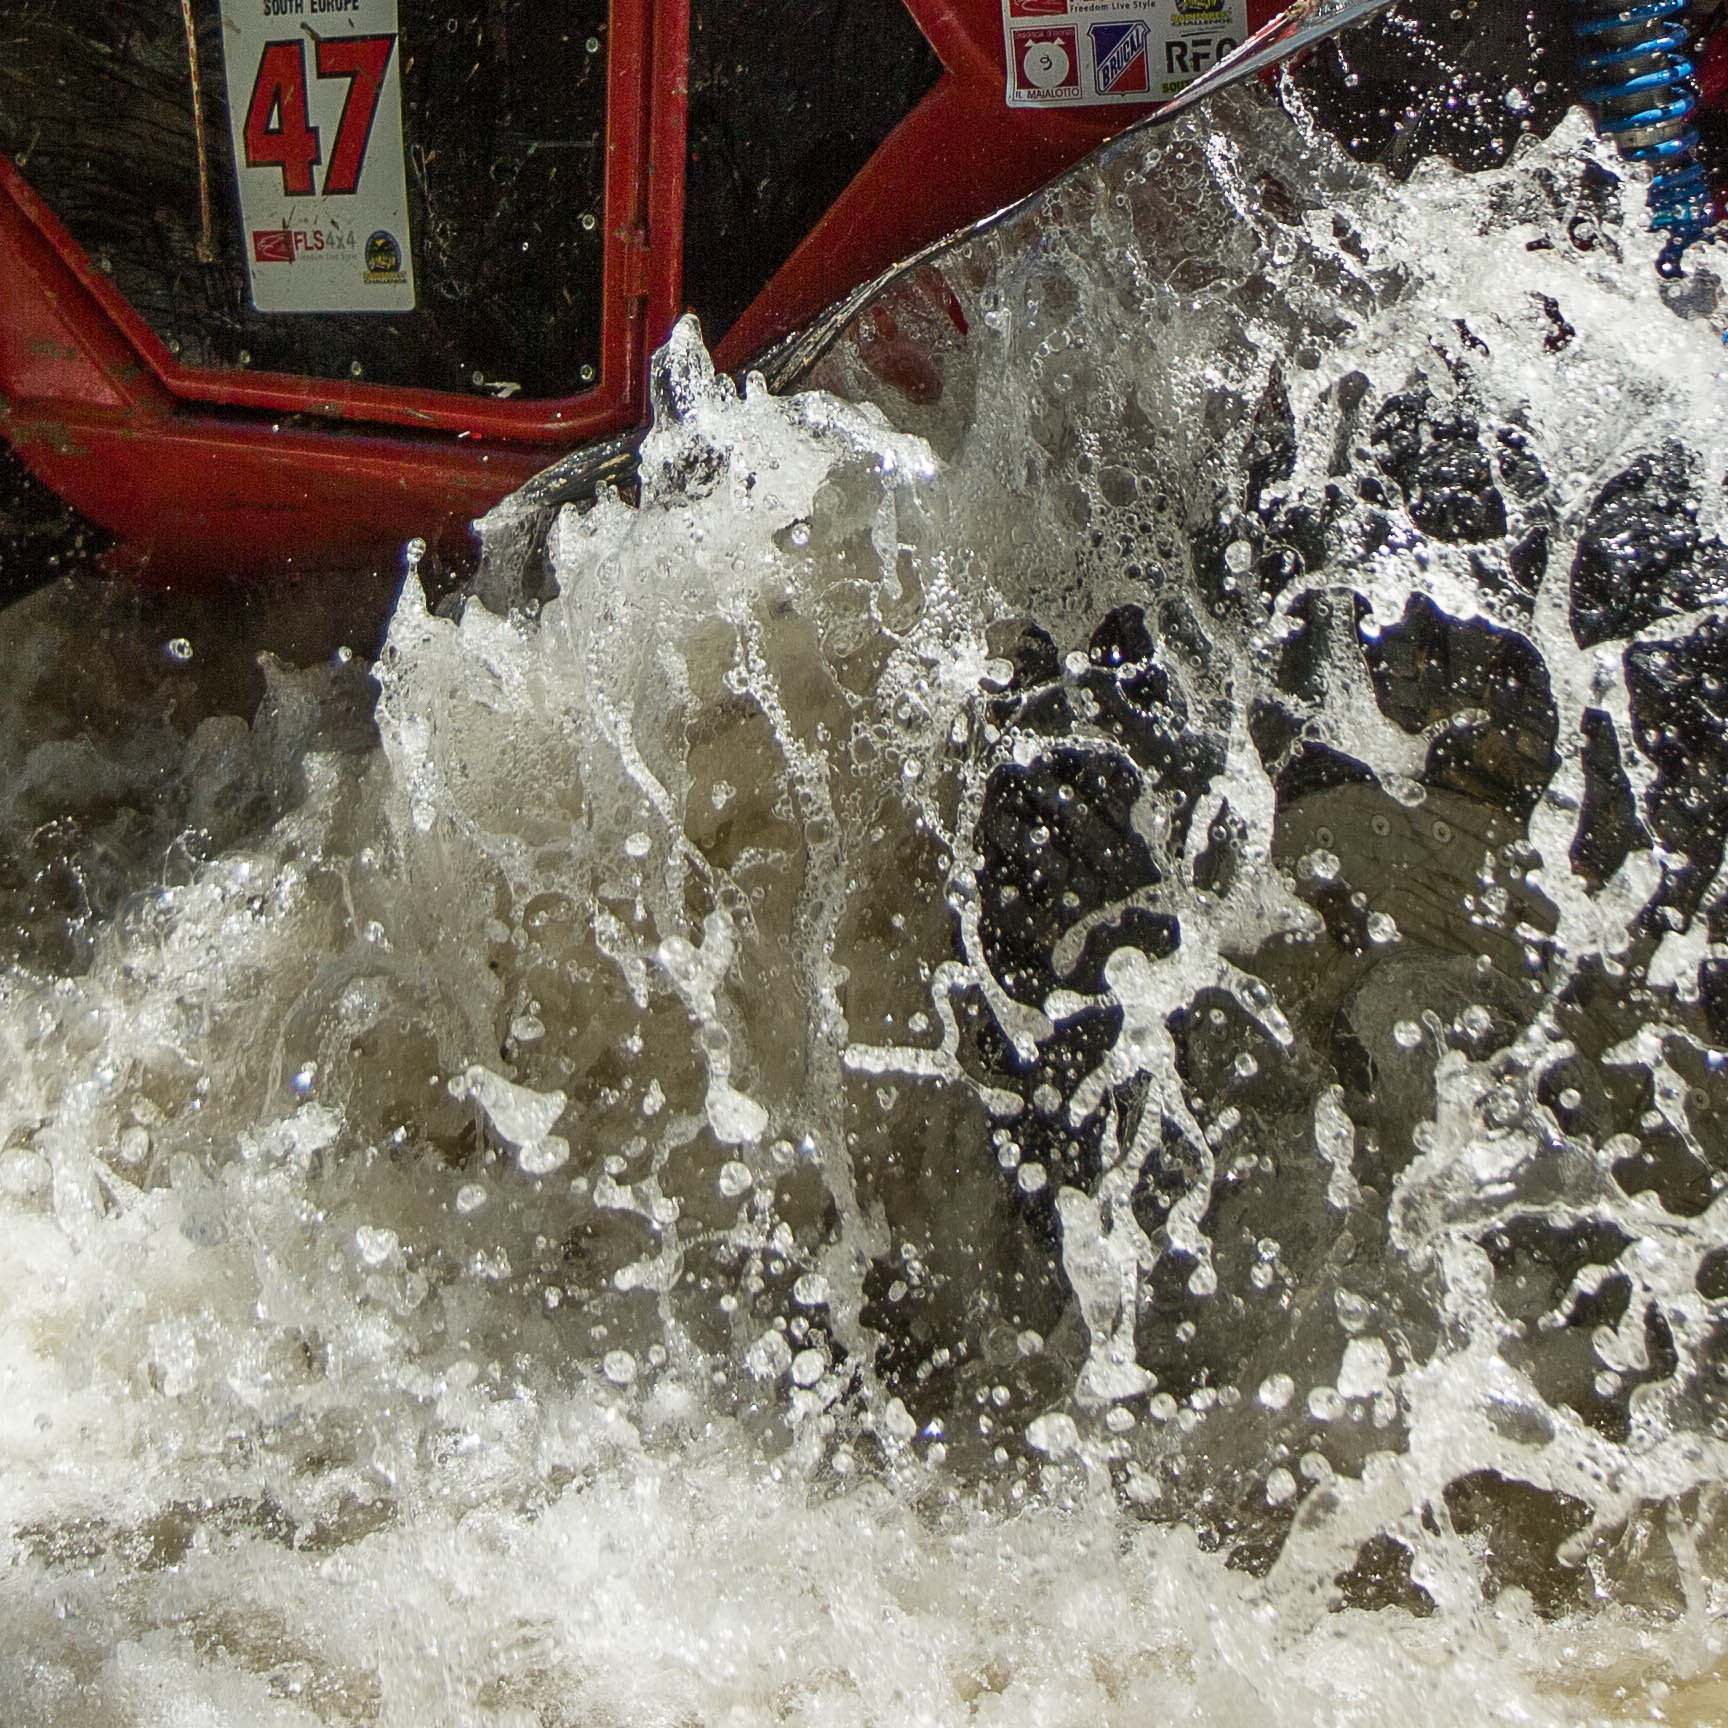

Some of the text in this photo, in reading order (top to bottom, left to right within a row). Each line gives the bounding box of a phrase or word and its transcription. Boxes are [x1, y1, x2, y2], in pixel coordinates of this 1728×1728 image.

[1112, 2, 1131, 11] Live
[1133, 0, 1156, 10] Style
[1101, 28, 1144, 89] BRUGAL
[1027, 88, 1080, 100] MAIALOTTO
[243, 33, 399, 197] 47
[294, 229, 357, 252] FLS4x4
